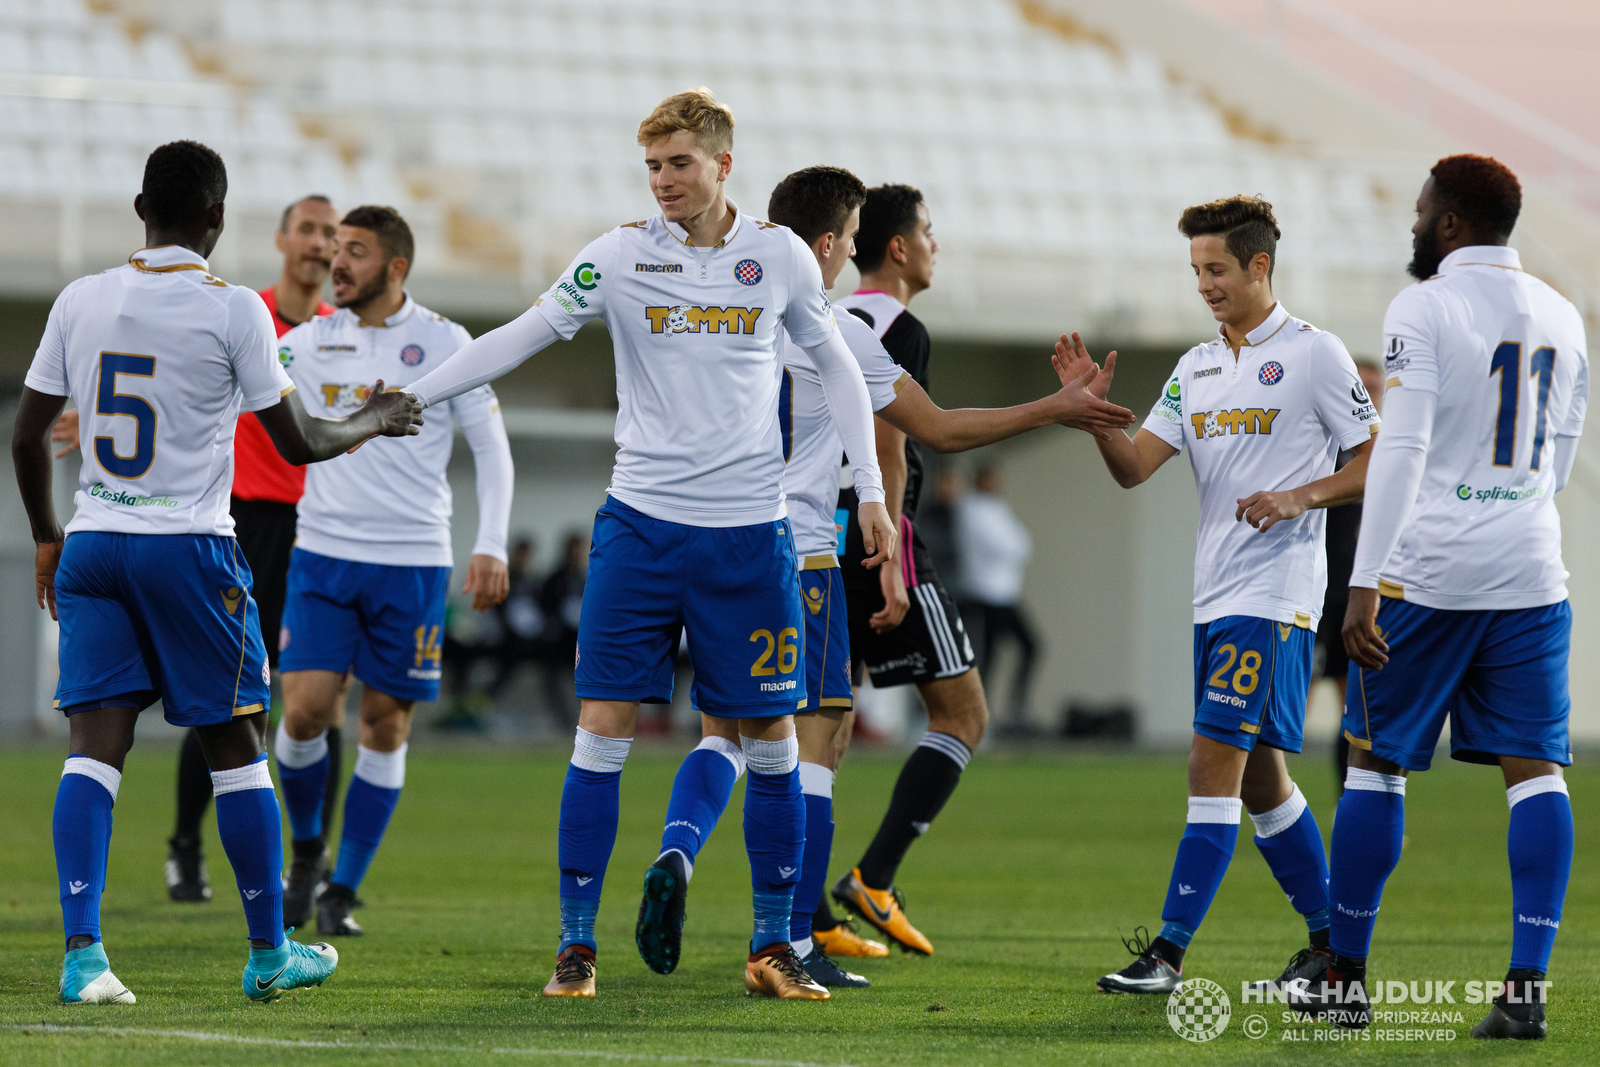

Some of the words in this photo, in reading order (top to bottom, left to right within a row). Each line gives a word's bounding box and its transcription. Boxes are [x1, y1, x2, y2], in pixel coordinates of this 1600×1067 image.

[635, 262, 683, 273] macron
[551, 290, 575, 314] banka
[557, 282, 588, 309] plitska
[645, 305, 764, 335] TOMMY
[1193, 366, 1222, 380] macron
[93, 350, 158, 480] 5
[1489, 340, 1557, 473] 11
[1191, 407, 1282, 440] TOMMY
[414, 624, 442, 668] 14
[749, 627, 798, 676] 26
[1208, 643, 1262, 696] 28
[760, 680, 797, 691] macron
[1207, 691, 1247, 709] macron
